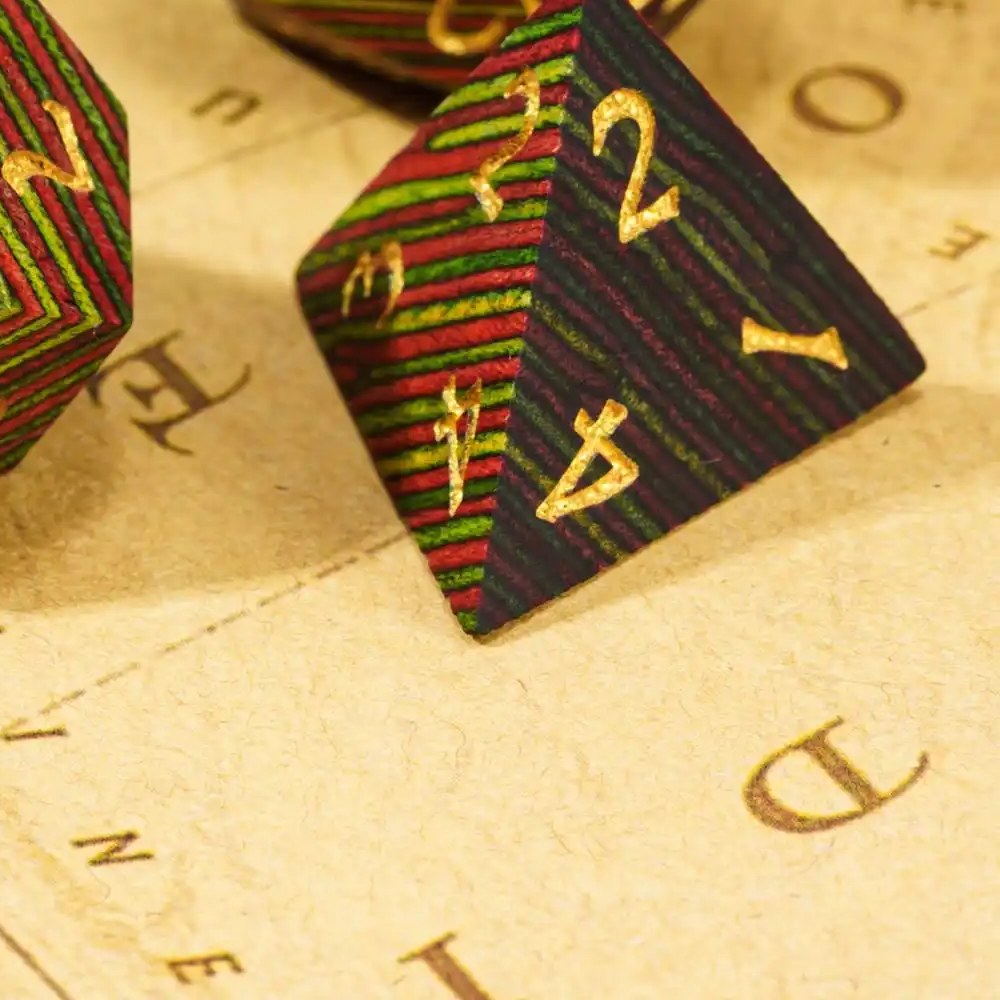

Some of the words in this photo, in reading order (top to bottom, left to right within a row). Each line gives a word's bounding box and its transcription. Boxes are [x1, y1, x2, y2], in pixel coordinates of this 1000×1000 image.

[591, 86, 681, 244] 2
[740, 316, 849, 370] 1
[535, 398, 639, 524] 4
